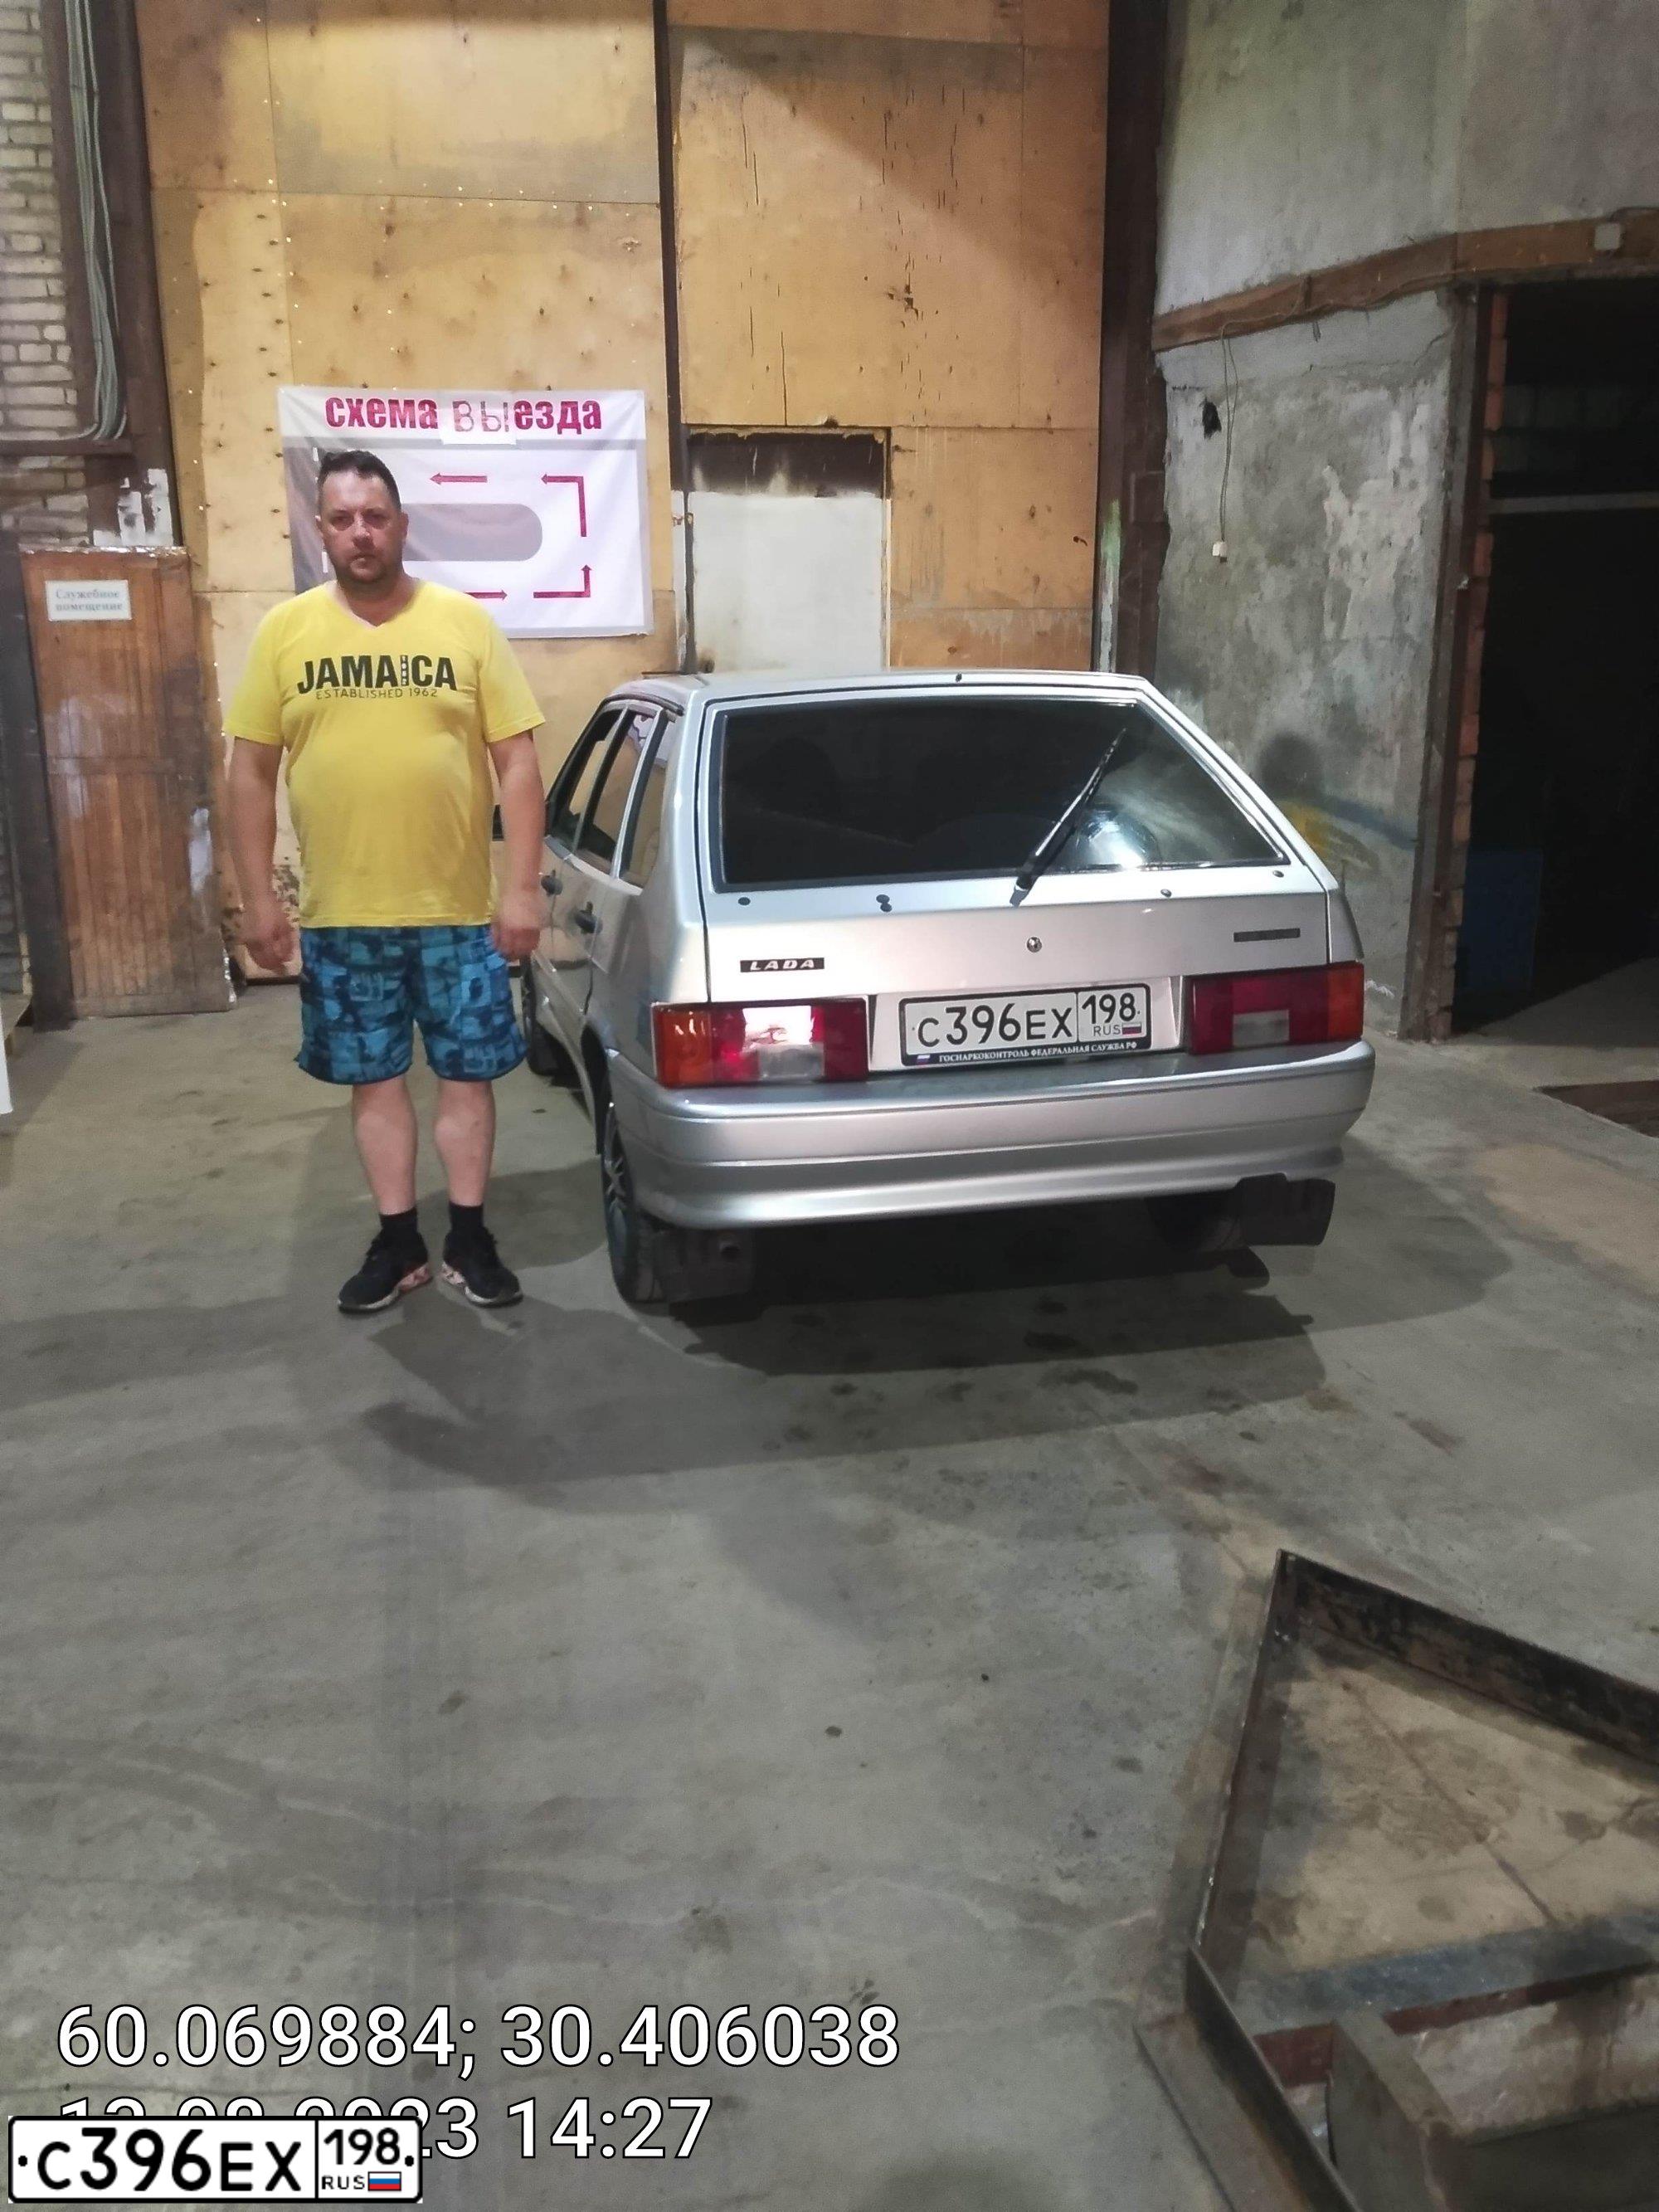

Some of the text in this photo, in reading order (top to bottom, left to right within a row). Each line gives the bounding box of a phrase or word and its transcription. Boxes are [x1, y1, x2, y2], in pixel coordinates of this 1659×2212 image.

[325, 397, 438, 430] схема
[297, 655, 458, 694] JAMAICA
[316, 688, 438, 699] ESTABLISHED 1962
[749, 959, 815, 971] LADA
[1082, 992, 1136, 1024] 198
[1093, 1023, 1121, 1036] RUS
[938, 1041, 1137, 1062] ГОСНАРКОКОНТРОЛЬ ФЕДЕРАЛЬНАЯ СЛУЖБА РФ
